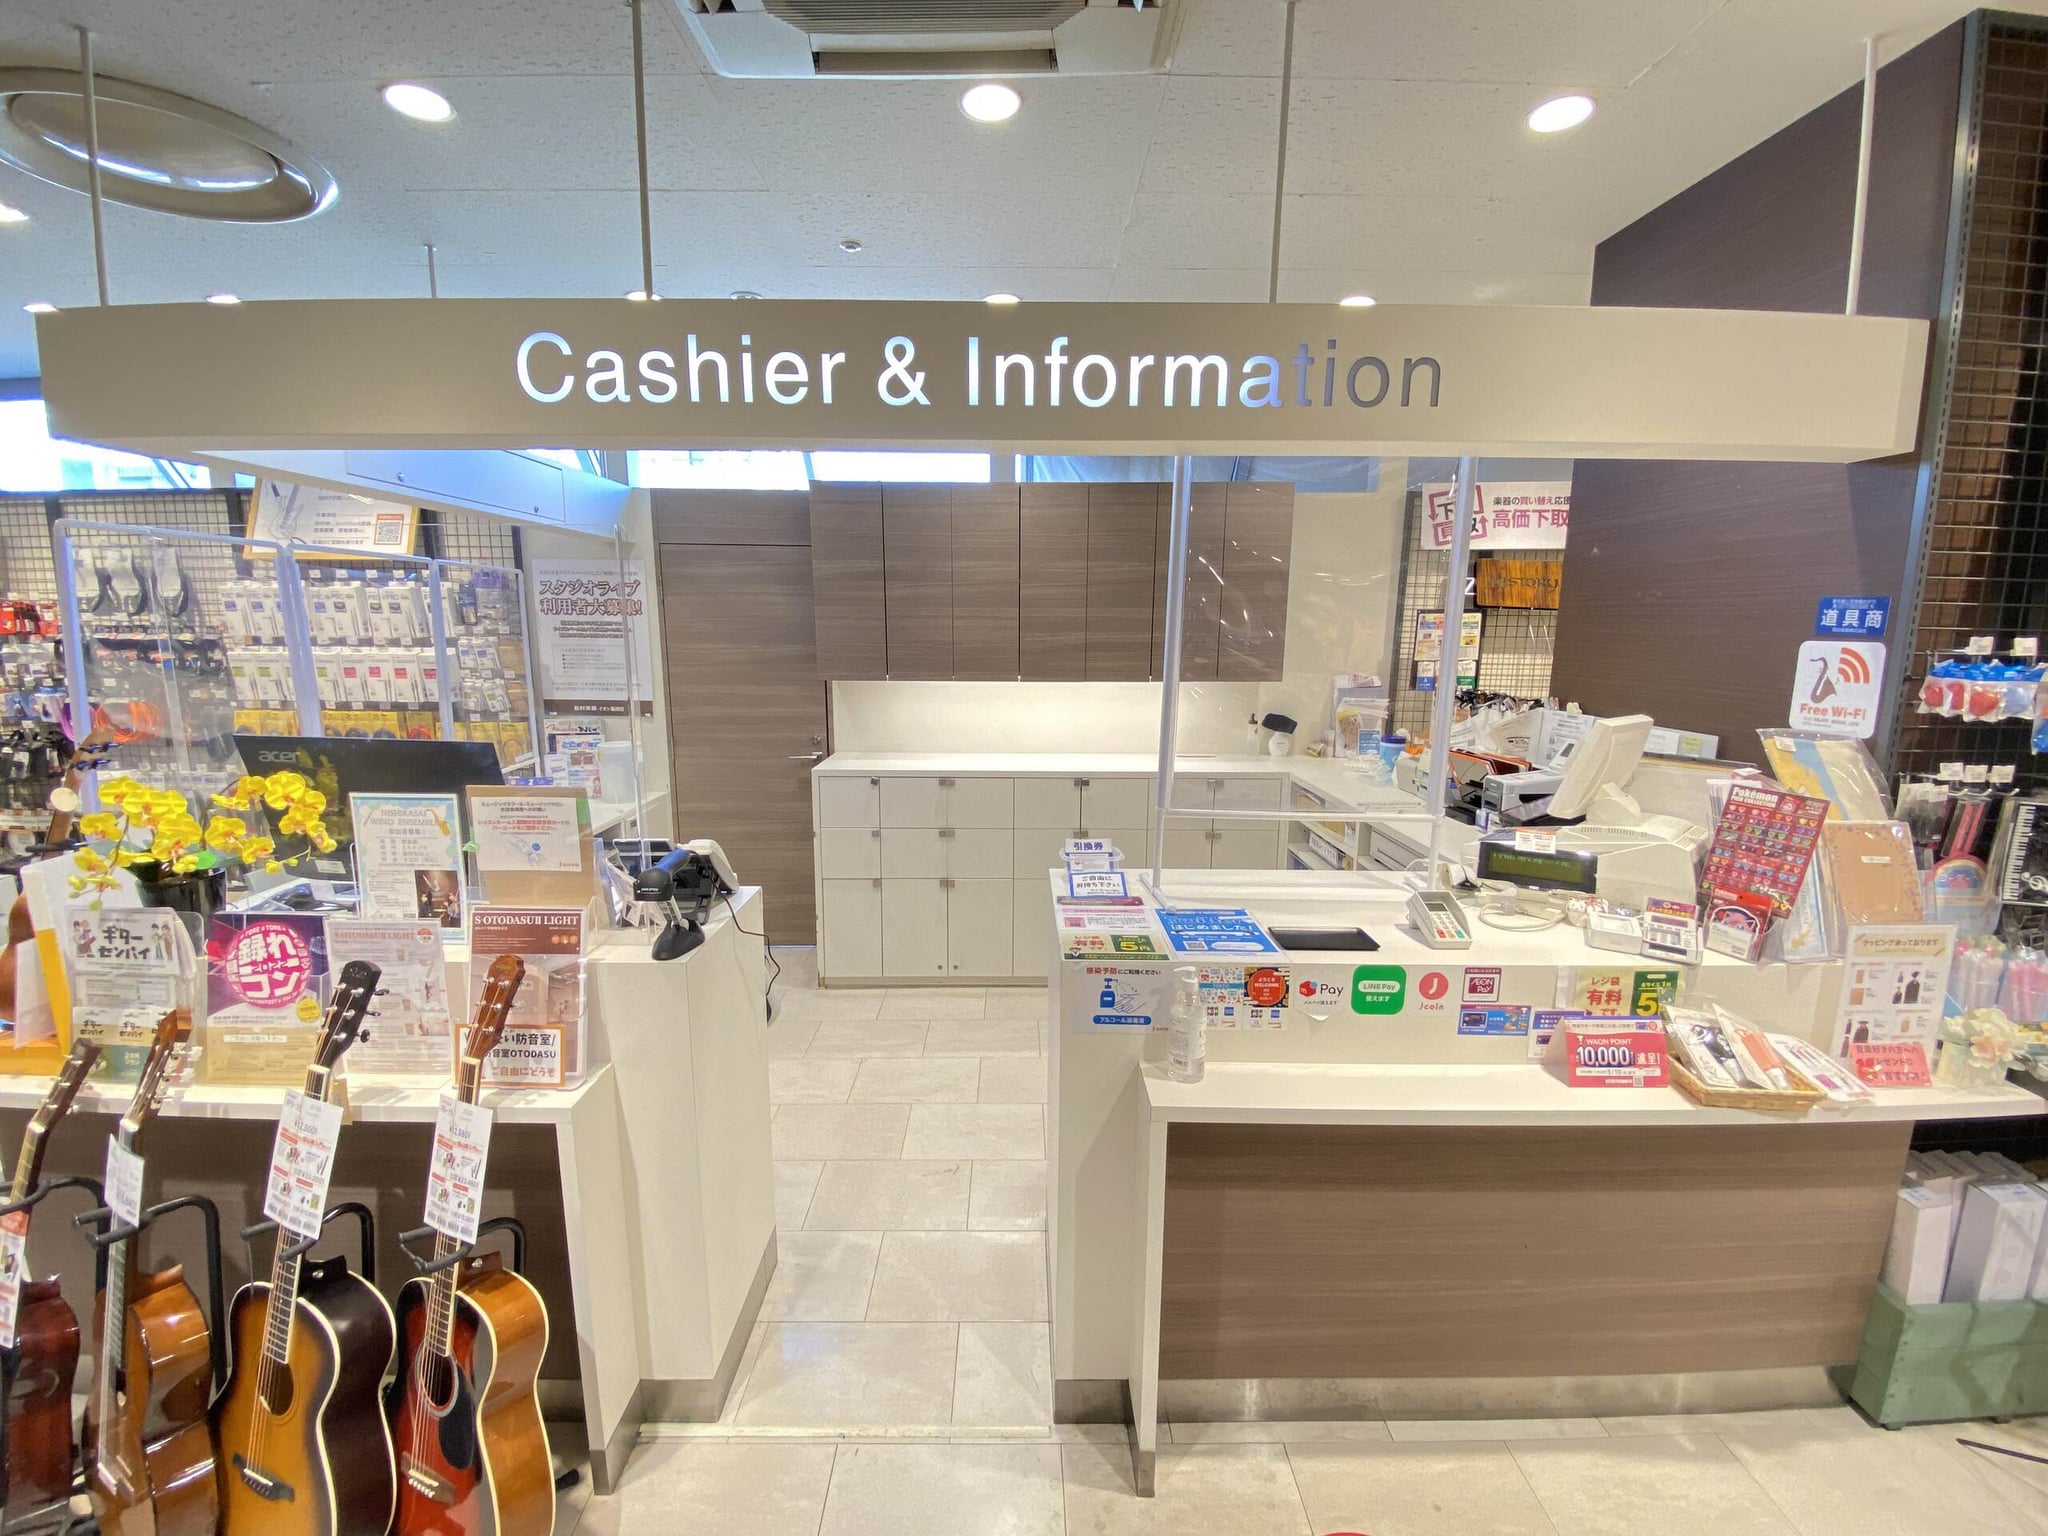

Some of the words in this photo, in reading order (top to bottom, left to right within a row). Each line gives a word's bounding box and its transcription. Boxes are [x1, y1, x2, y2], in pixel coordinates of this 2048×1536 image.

[516, 331, 847, 404] Cashier
[877, 335, 931, 406] &
[968, 336, 1441, 407] Information
[1820, 609, 1884, 629] 道具商
[1800, 703, 1829, 716] Free
[1831, 706, 1868, 720] Wi-Fi
[257, 749, 300, 763] acer
[1732, 786, 1779, 802] Pokémon
[1073, 841, 1103, 851] 引換券
[544, 915, 579, 925] LIGHT
[101, 925, 144, 945] ギター
[98, 946, 151, 959] センパイ
[240, 971, 300, 998] コン
[1320, 983, 1344, 998] Pay
[1382, 983, 1397, 991] Pay
[1586, 989, 1622, 1006] 有料
[1585, 1038, 1610, 1046] WAON
[1610, 1038, 1633, 1046] POINT
[1576, 1046, 1630, 1067] 10,000
